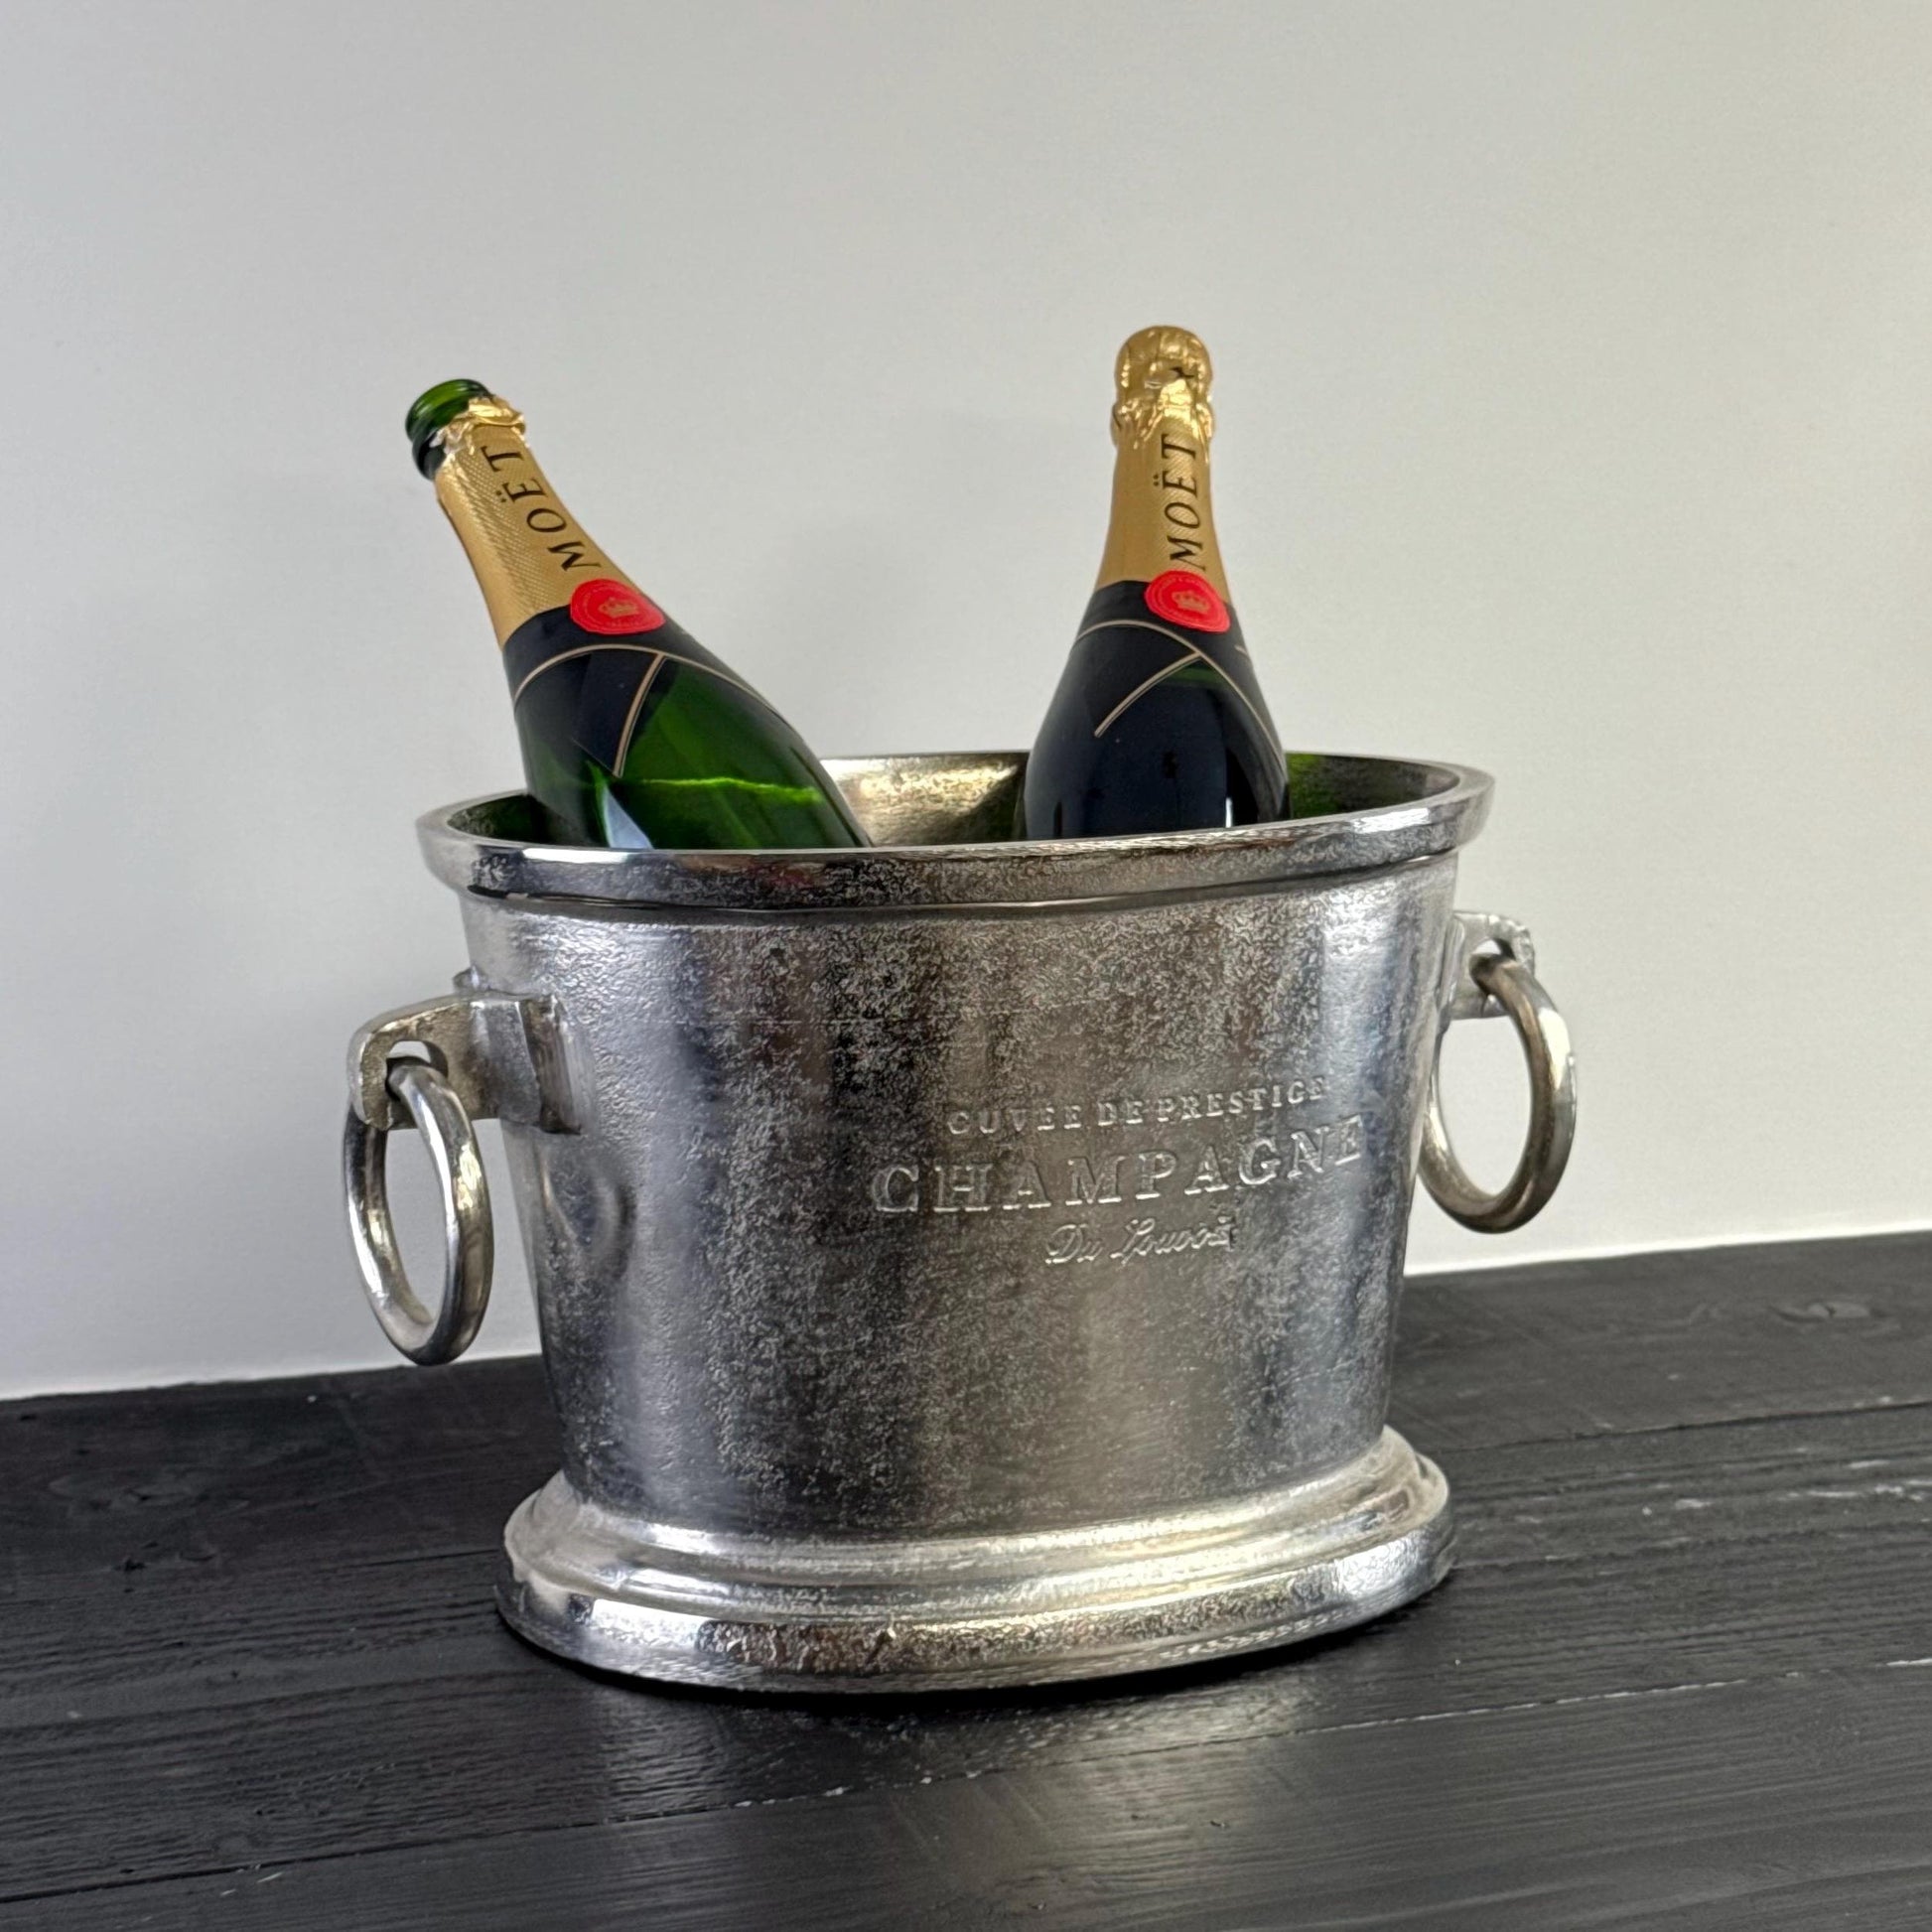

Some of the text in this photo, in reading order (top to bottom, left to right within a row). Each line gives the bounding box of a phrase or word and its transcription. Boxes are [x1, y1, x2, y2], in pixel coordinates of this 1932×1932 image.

[481, 445, 602, 572] MOËT
[1153, 433, 1206, 572] MOËT
[871, 1114, 1364, 1213] CHAMPAGNE
[1097, 1100, 1144, 1127] DE
